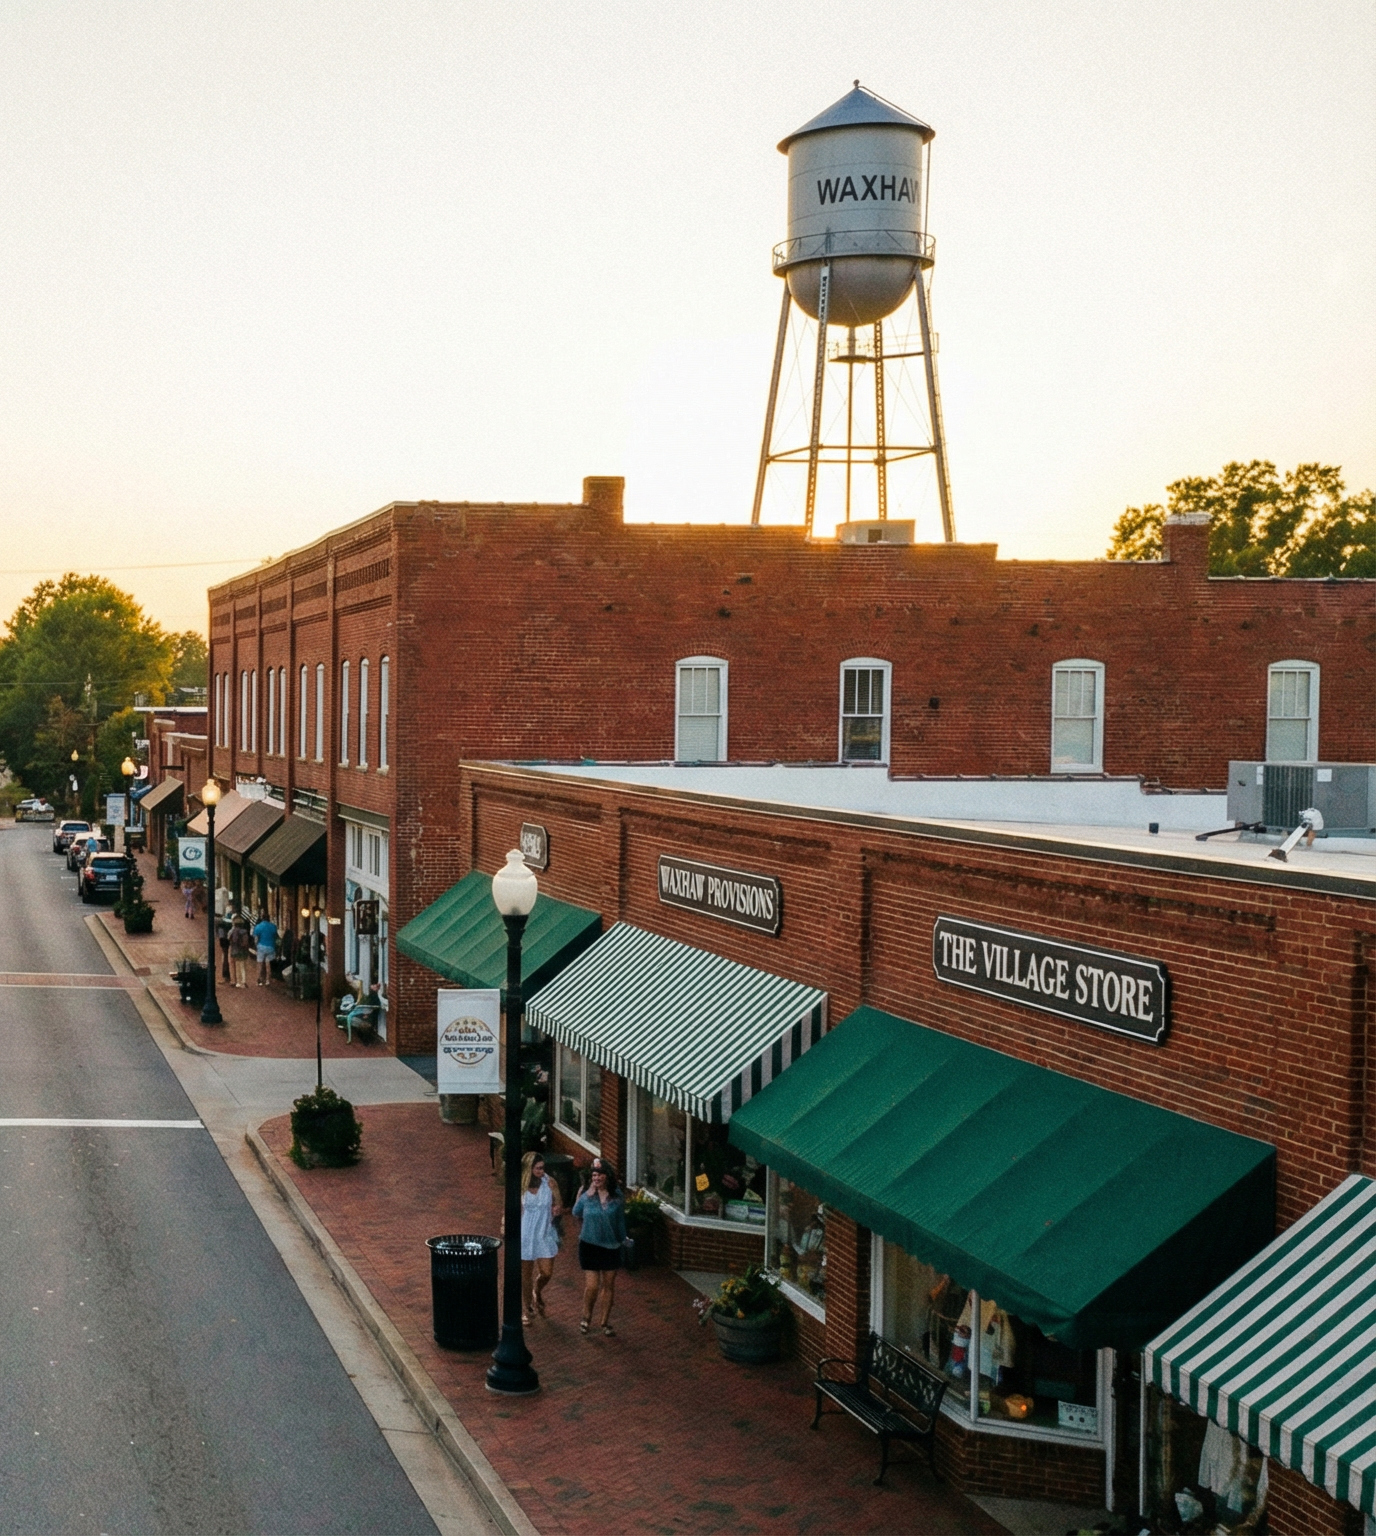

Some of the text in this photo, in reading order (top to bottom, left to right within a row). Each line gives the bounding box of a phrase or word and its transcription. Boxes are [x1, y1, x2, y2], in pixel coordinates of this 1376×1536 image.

[660, 864, 774, 920] WAXHAW PROVISIONS
[939, 930, 1154, 1023] THE VILLAGE STORE
